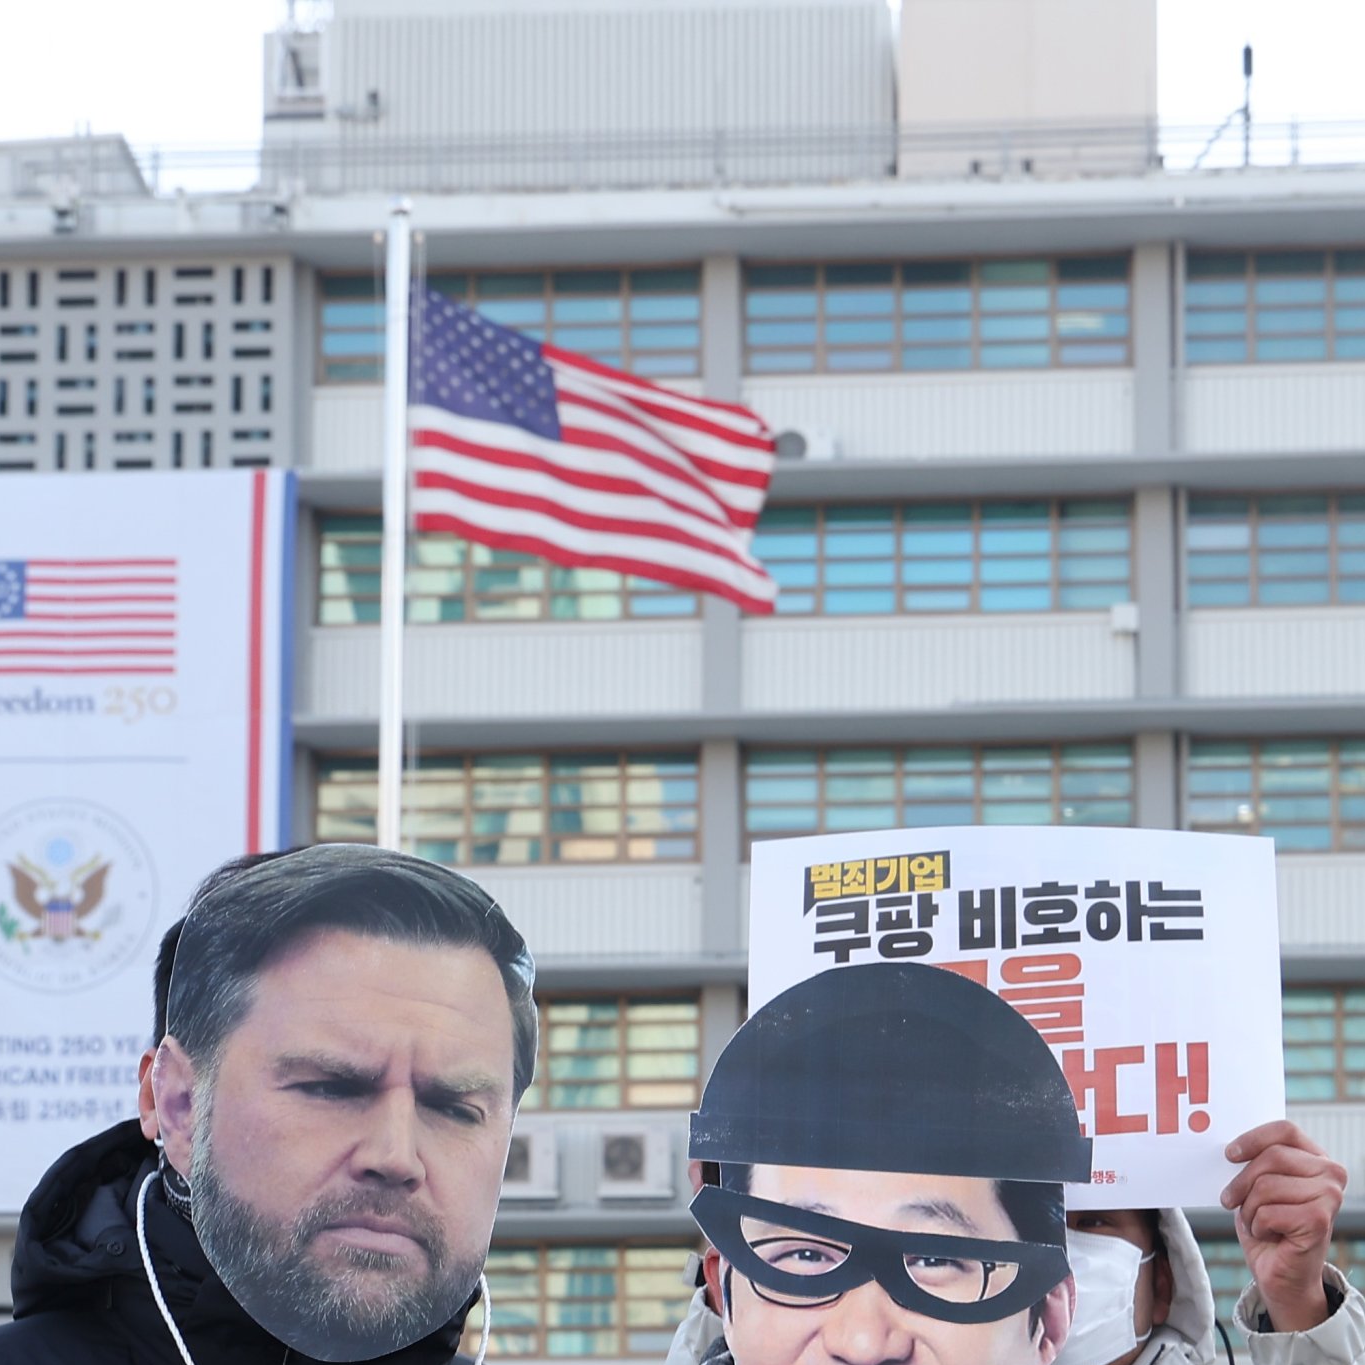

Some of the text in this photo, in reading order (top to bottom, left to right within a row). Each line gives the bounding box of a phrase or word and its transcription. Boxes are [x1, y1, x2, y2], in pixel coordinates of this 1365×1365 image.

[103, 685, 180, 725] 250
[810, 854, 945, 900] 범죄기업
[813, 880, 1204, 963] 쿠팡 비호하는
[929, 952, 1085, 1045] 을
[61, 1036, 105, 1057] 250
